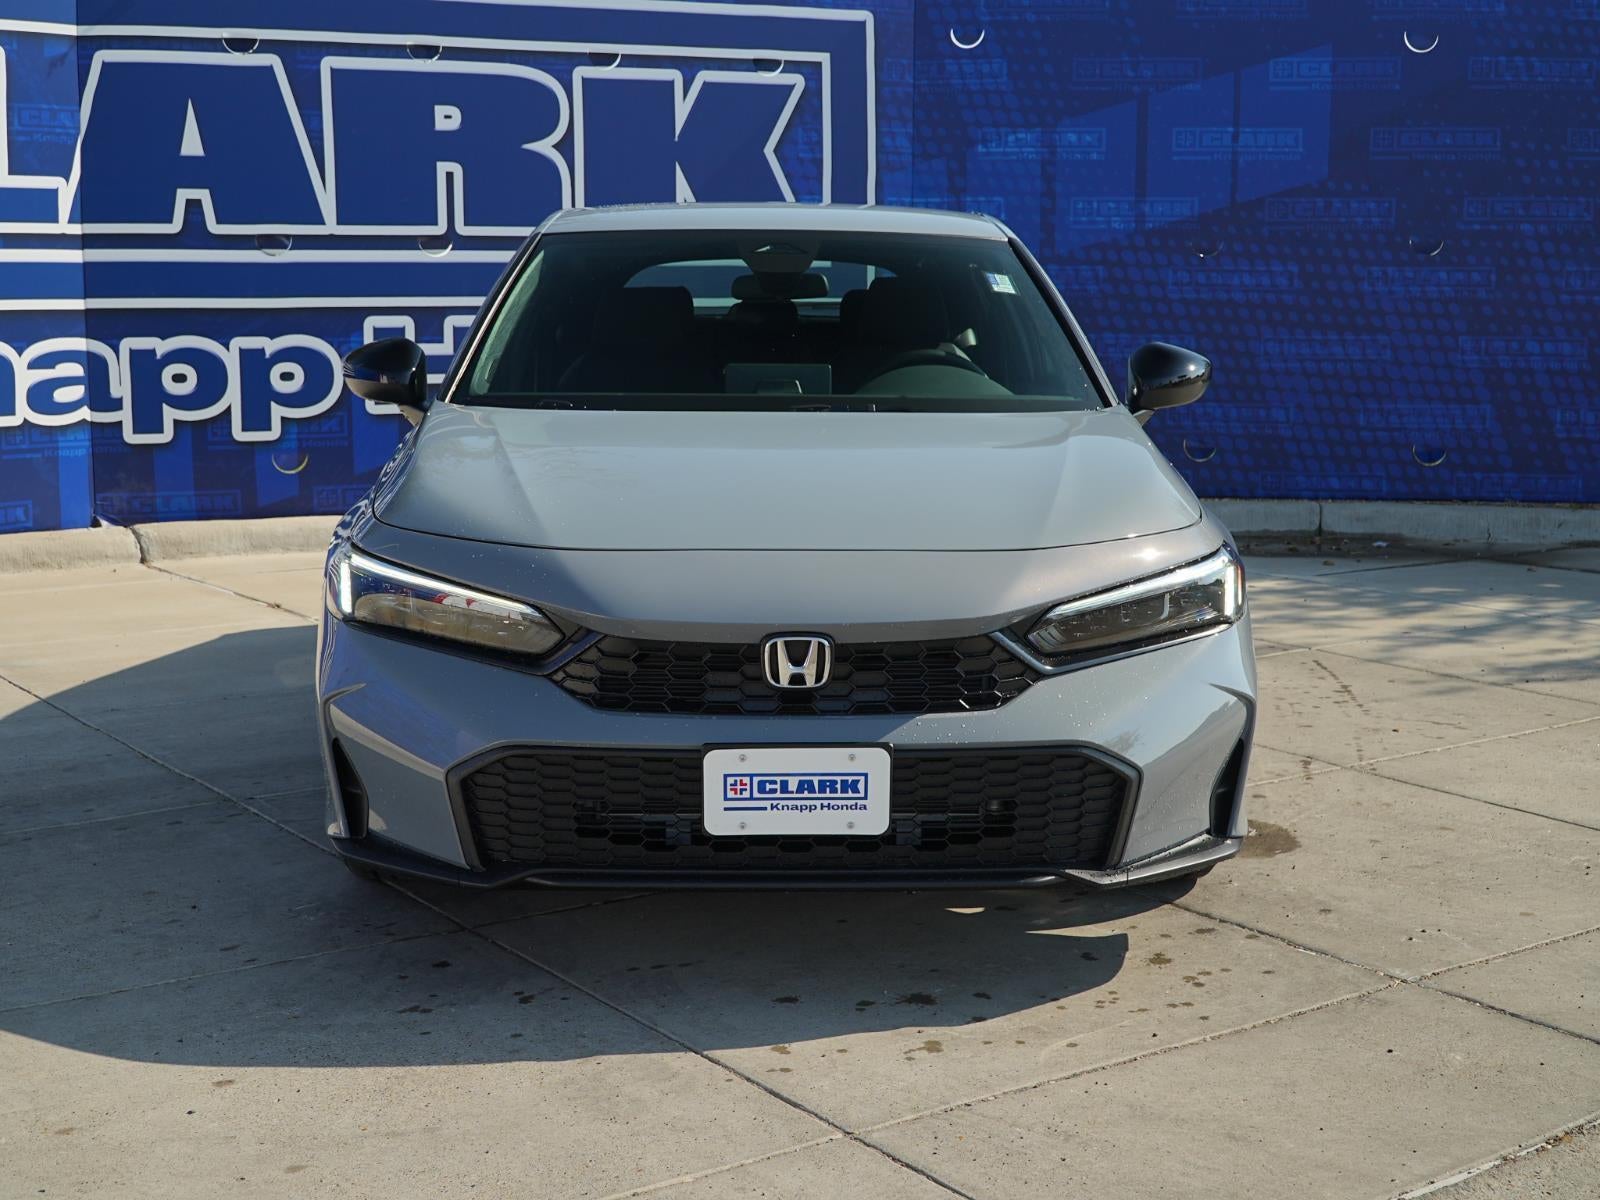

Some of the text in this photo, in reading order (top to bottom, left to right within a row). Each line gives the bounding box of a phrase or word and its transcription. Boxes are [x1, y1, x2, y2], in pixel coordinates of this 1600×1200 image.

[0, 336, 344, 444] app
[757, 779, 861, 795] CLARK
[770, 802, 868, 813] Knapp Honda
